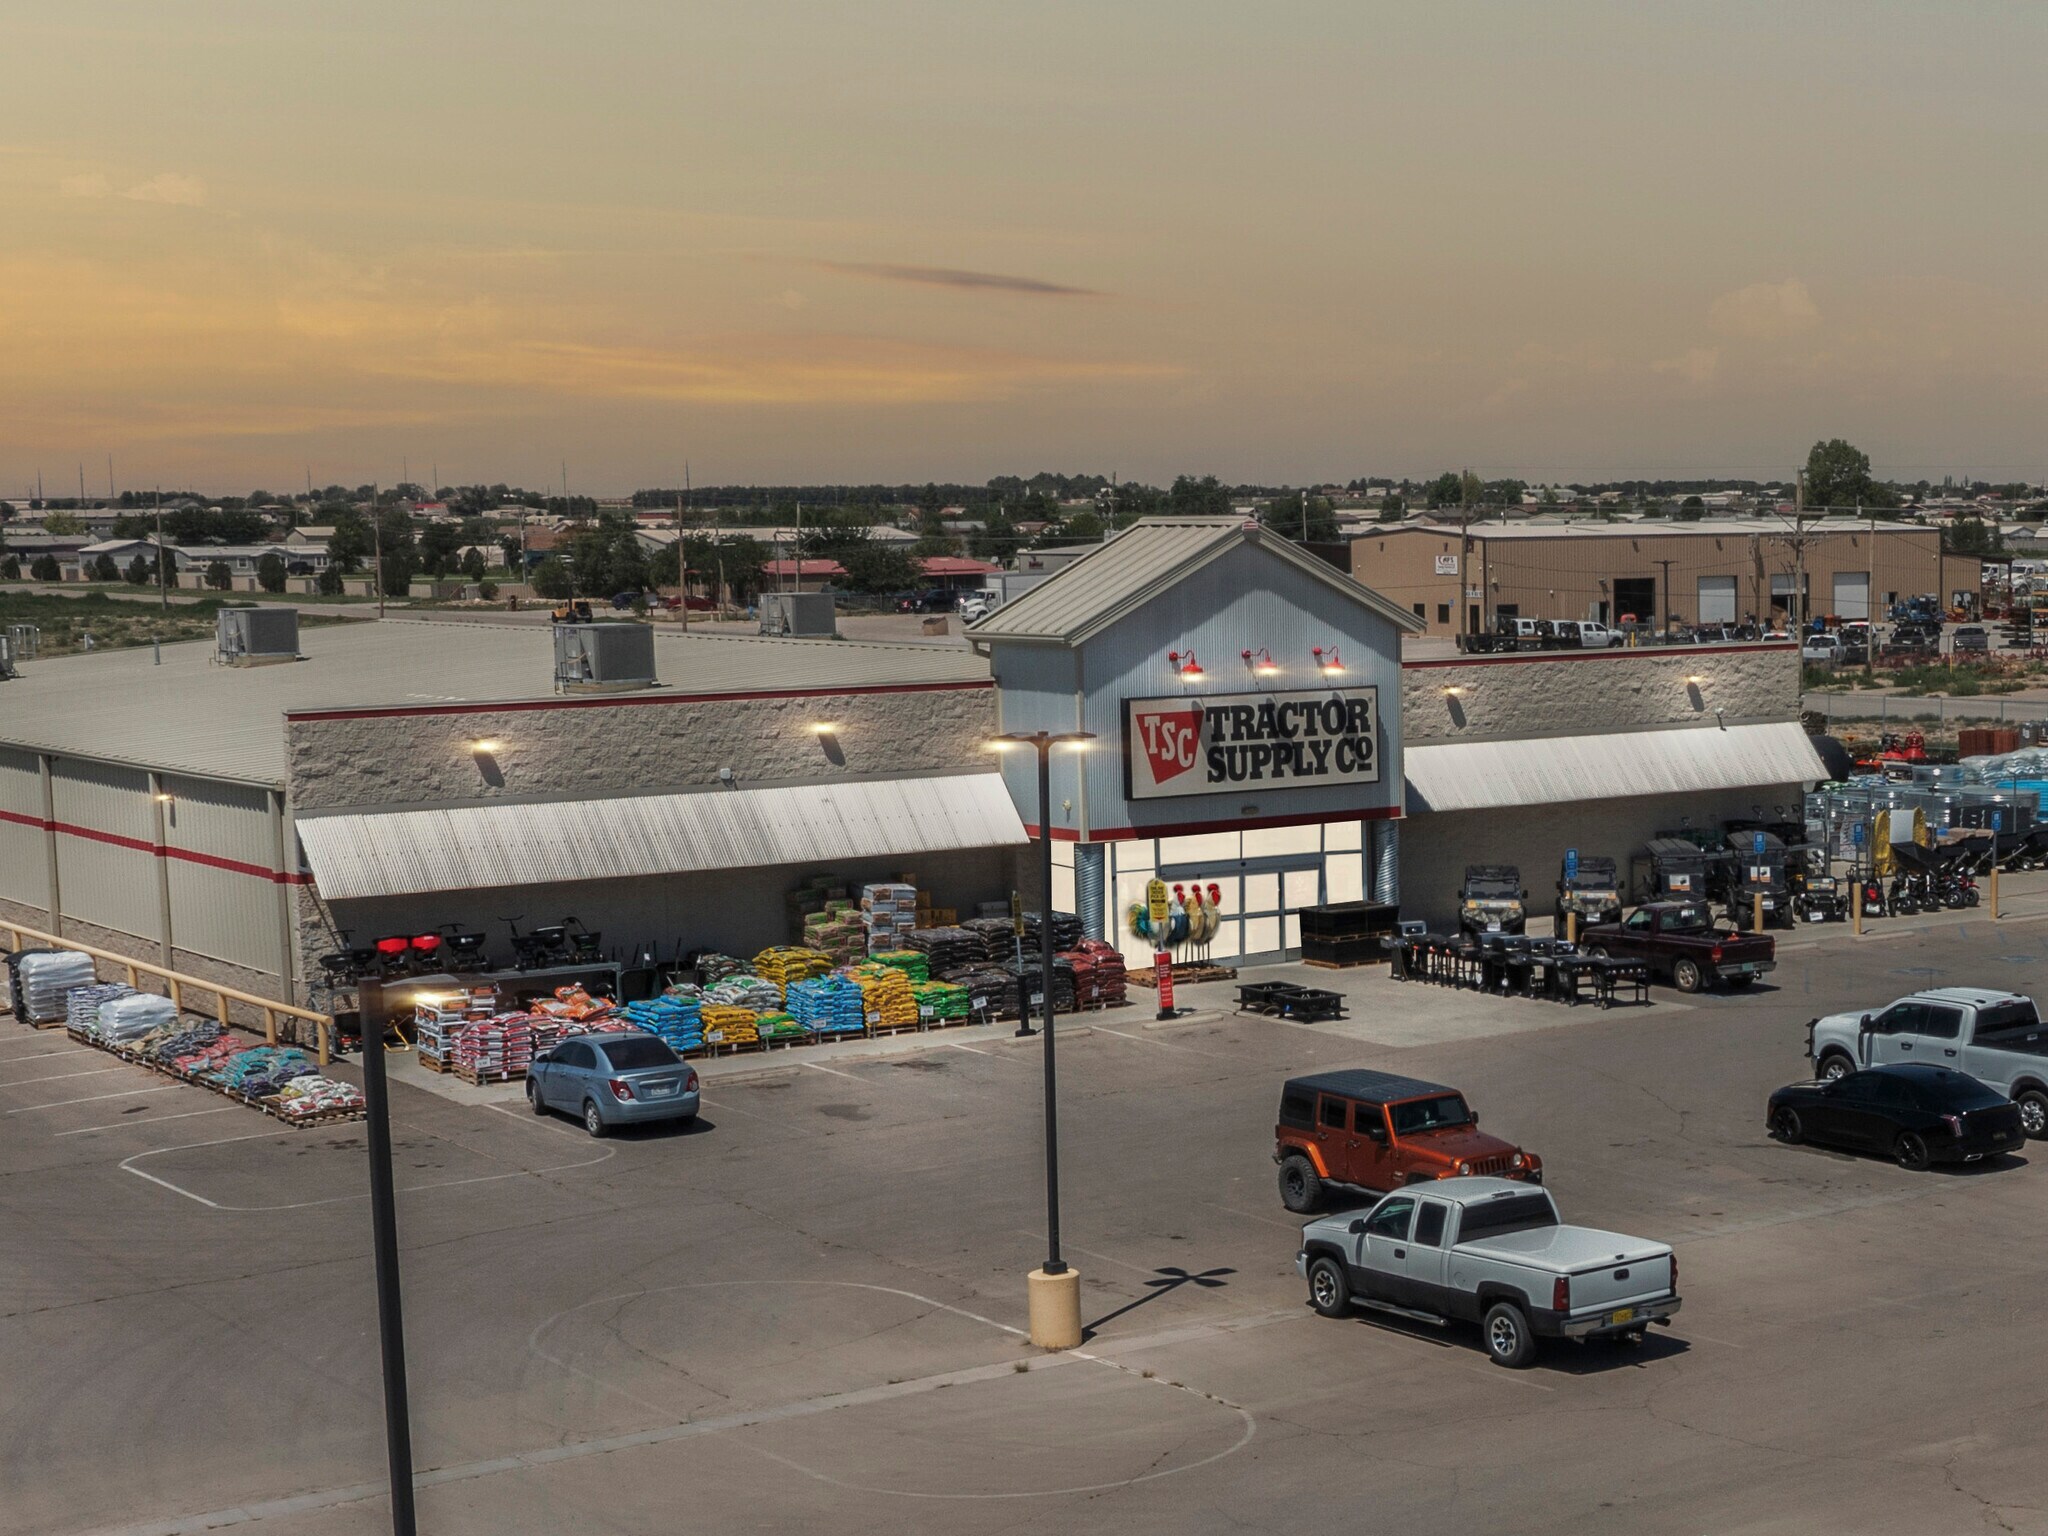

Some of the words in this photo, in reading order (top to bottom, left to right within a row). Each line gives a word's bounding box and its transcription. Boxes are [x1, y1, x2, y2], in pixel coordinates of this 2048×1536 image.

[1144, 715, 1193, 768] TSC
[1206, 698, 1371, 742] TRACTOR
[1207, 739, 1332, 783] SUPPLY
